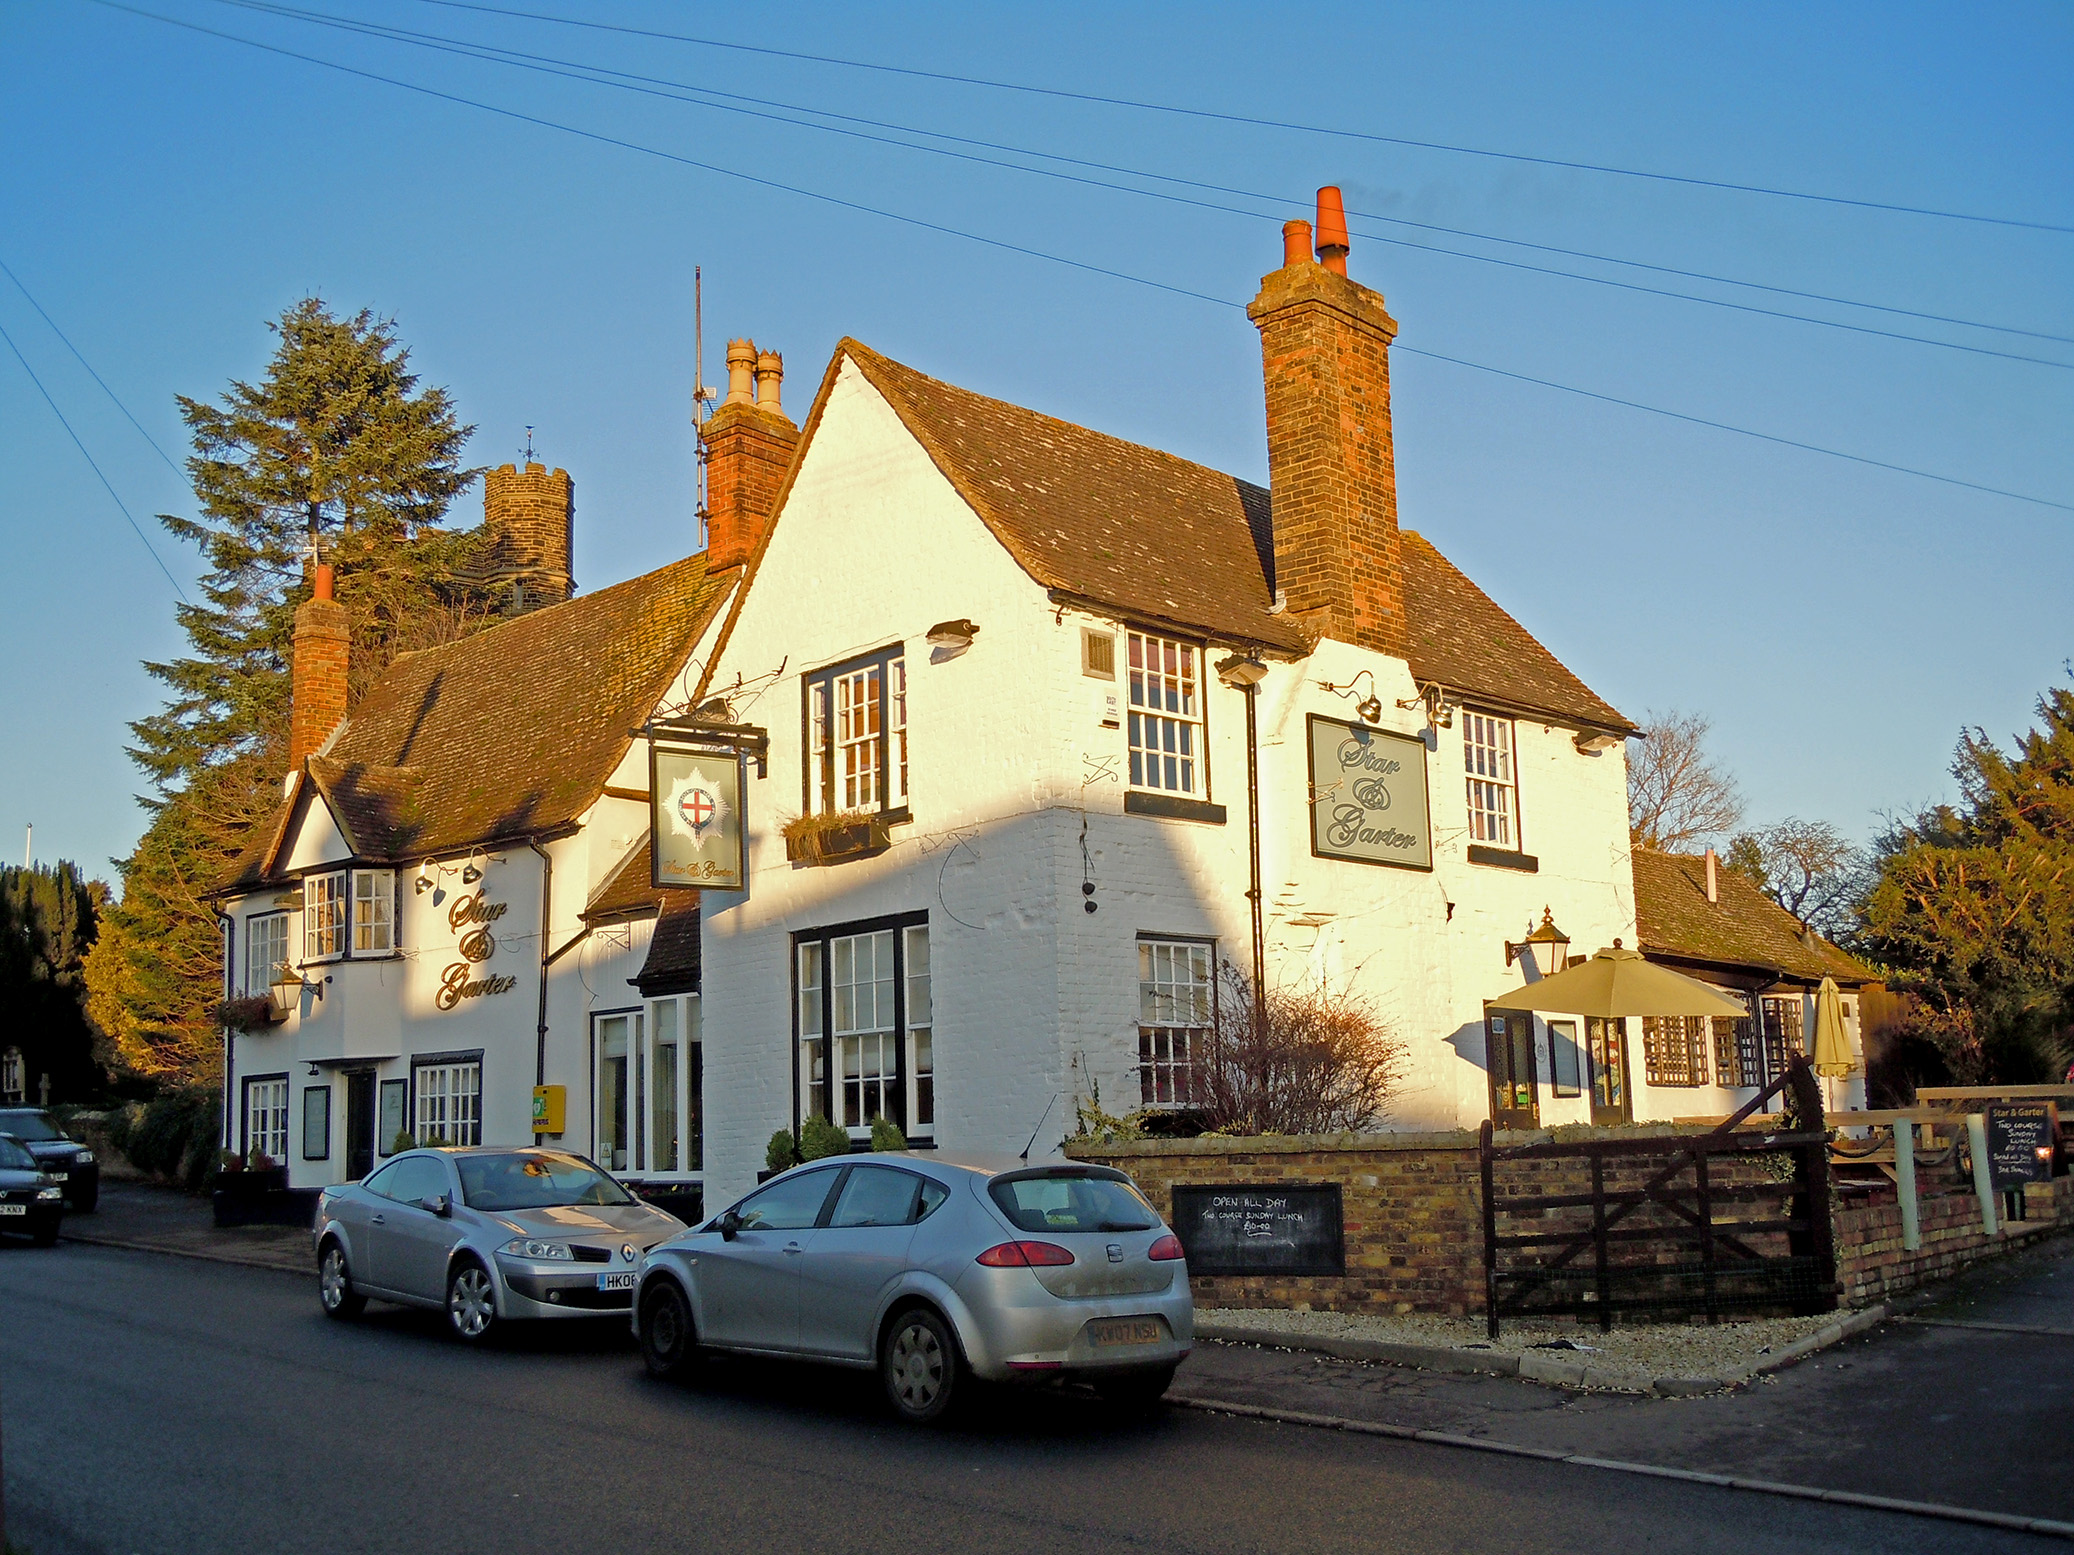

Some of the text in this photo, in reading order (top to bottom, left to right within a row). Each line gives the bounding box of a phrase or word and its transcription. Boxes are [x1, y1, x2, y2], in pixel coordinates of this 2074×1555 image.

[1337, 738, 1400, 774] Star
[1352, 776, 1392, 810] &
[1326, 803, 1417, 849] Garter
[662, 860, 685, 875] Star
[702, 860, 734, 879] Garter
[448, 888, 507, 935] Star
[459, 923, 494, 962] &
[435, 962, 516, 1011] Garter
[1993, 1108, 2044, 1117] Star & Garter
[1213, 1196, 1287, 1208] OPEN ALL DAY
[1245, 1211, 1274, 1220] SUNDAY
[1278, 1213, 1303, 1222] LUNCH
